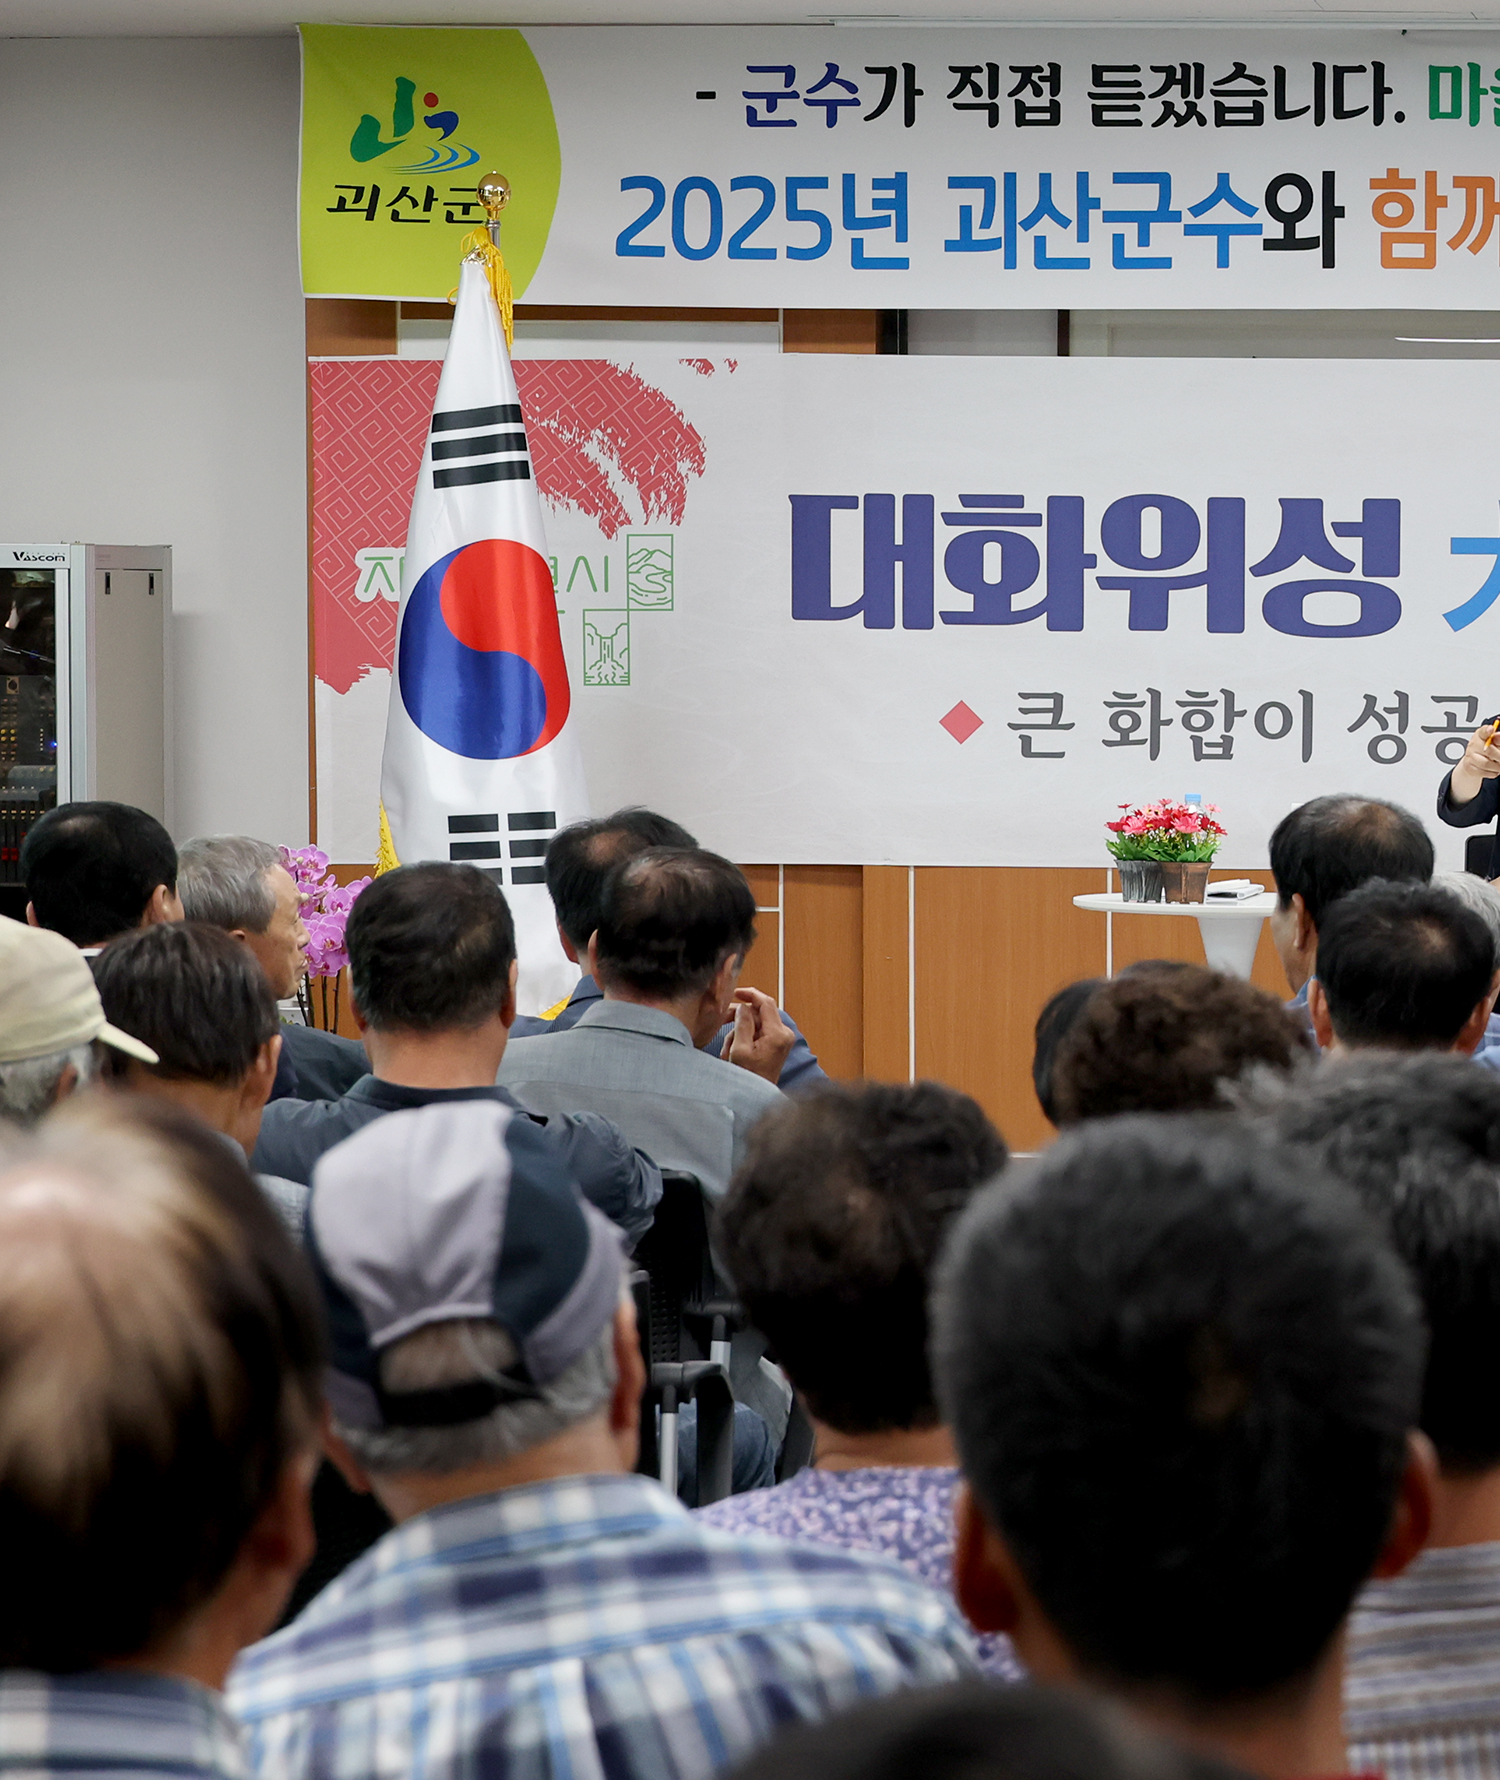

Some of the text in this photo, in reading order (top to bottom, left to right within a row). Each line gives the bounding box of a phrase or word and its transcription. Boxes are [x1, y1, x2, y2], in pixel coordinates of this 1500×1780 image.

[741, 63, 925, 129] 군수가
[946, 62, 1062, 128] 직접
[1087, 61, 1406, 129] 듣겠습니다.
[326, 184, 484, 223] 괴산군
[615, 171, 910, 271] 2025년
[944, 171, 1346, 270] 괴산군수와
[788, 493, 1402, 638] 대화위성
[1006, 691, 1076, 759] 큰
[1101, 687, 1314, 763] 화합이
